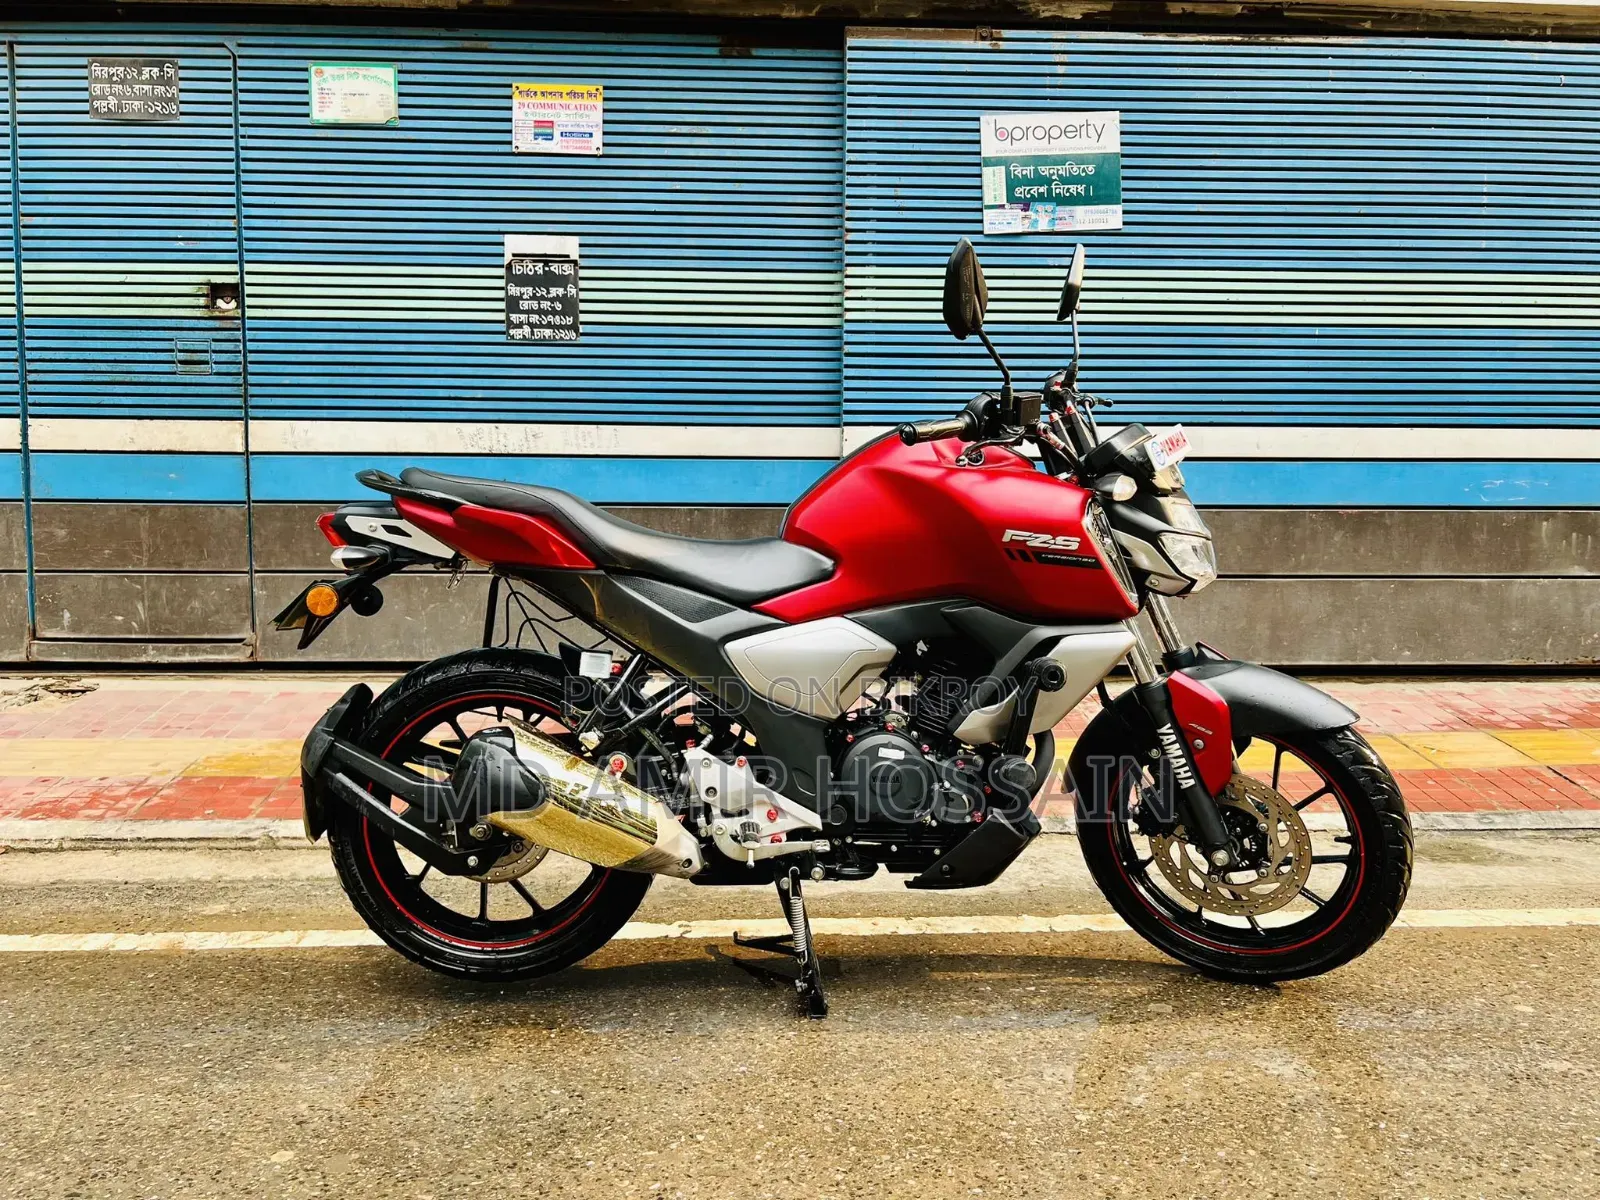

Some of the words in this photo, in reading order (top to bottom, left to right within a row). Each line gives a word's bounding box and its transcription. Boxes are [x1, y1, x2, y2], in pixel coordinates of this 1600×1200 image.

[91, 83, 111, 96] রোড
[518, 88, 538, 99] গার্ডকে
[540, 90, 563, 100] আপনার
[565, 90, 585, 100] পরিচয়
[586, 91, 598, 101] দিন
[517, 101, 526, 110] 29
[527, 102, 598, 111] COMMUNICATION
[994, 118, 1106, 147] bproperty
[1009, 163, 1035, 179] বিনা
[1037, 161, 1096, 180] অনুমতিতে
[1014, 184, 1048, 199] প্রবেশ
[519, 300, 539, 311] রোড
[509, 313, 528, 324] বাসা
[1156, 722, 1196, 790] YAMAHA
